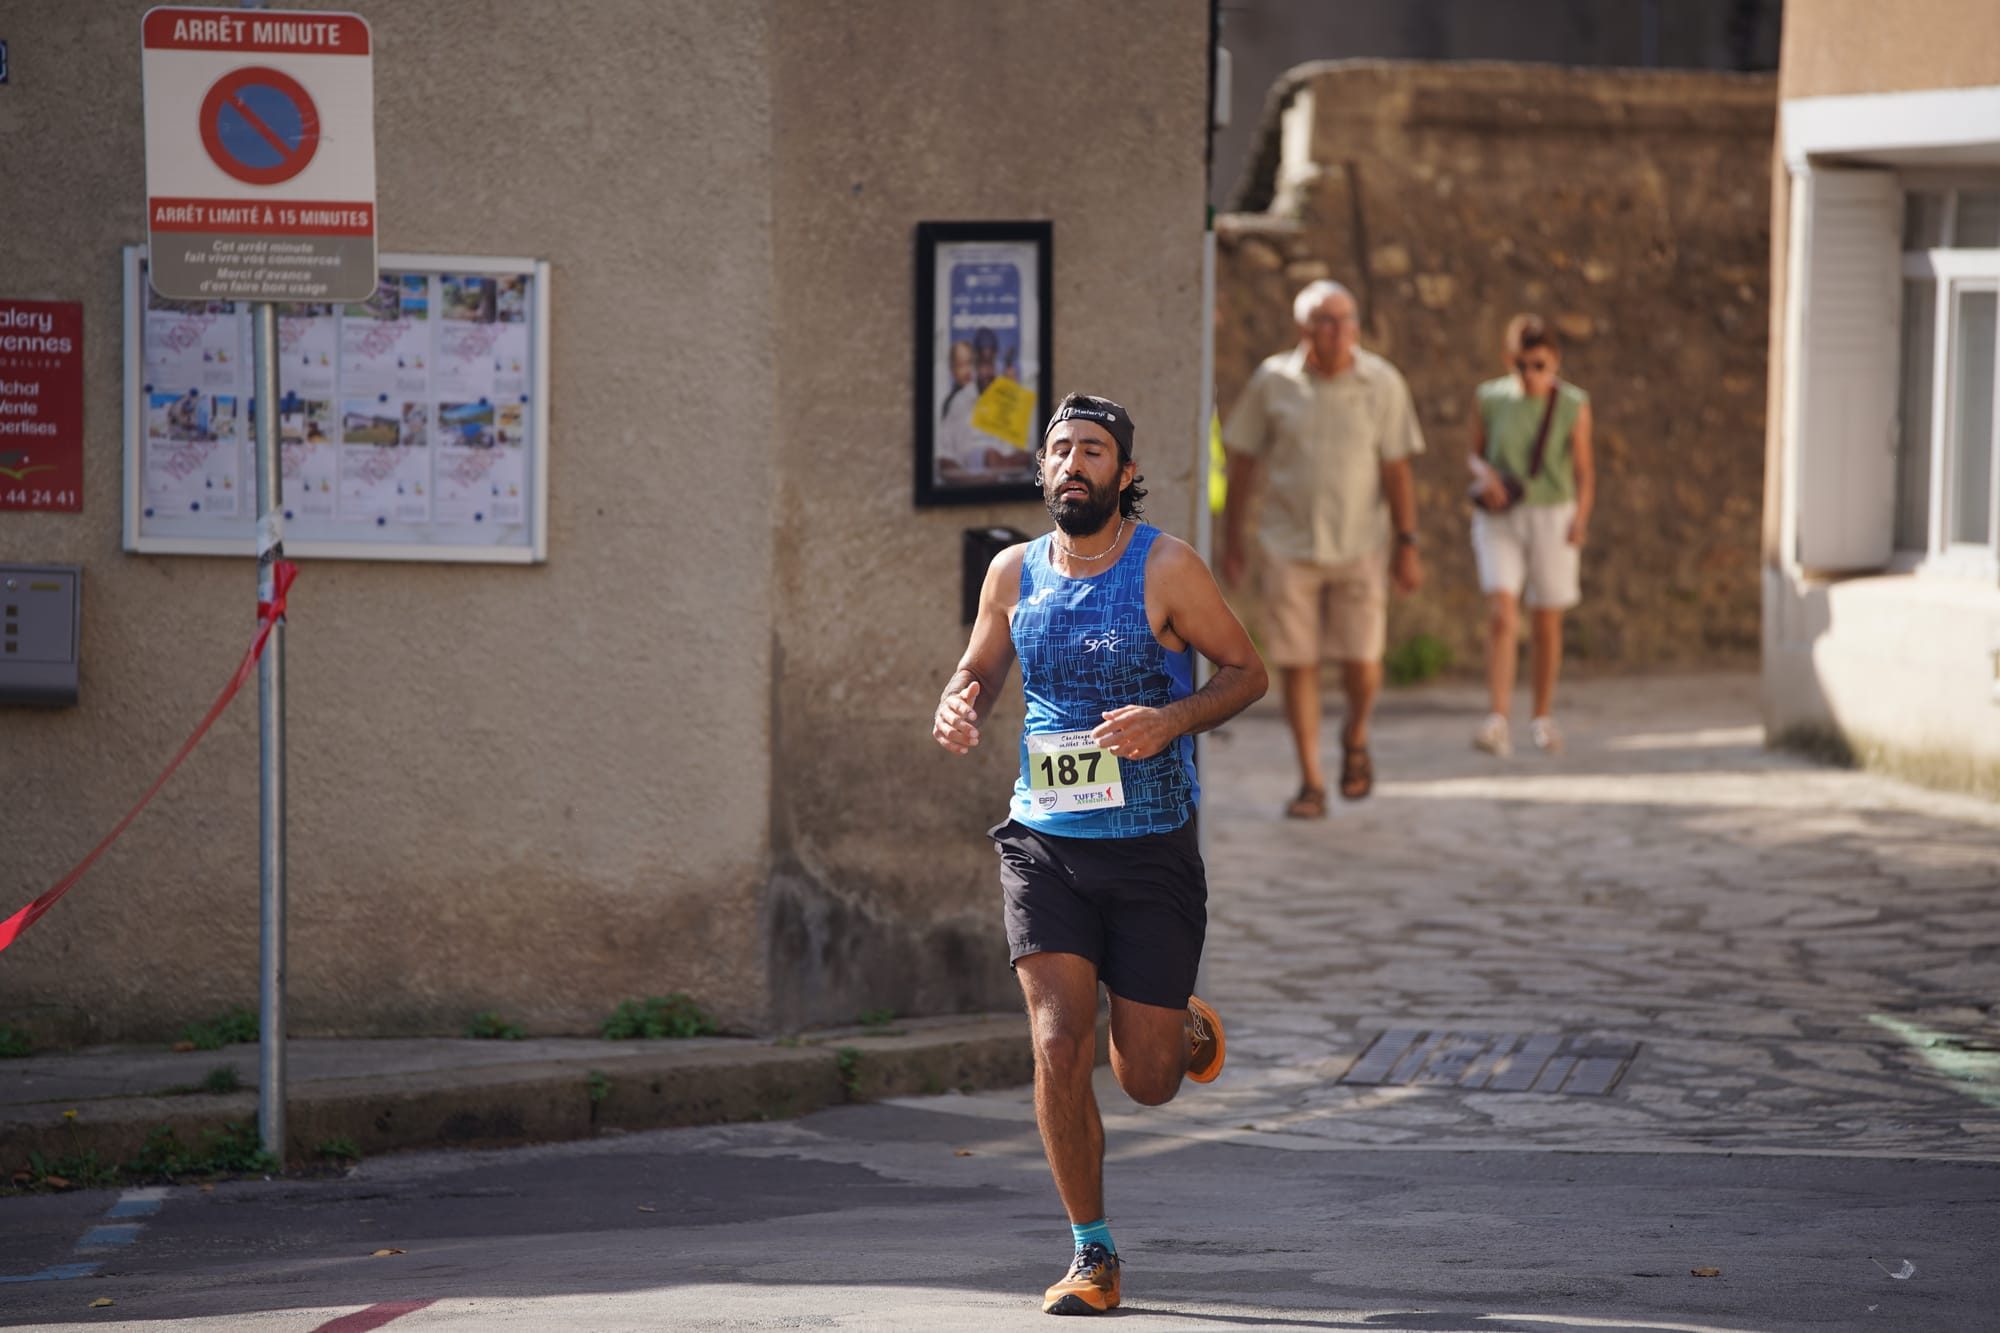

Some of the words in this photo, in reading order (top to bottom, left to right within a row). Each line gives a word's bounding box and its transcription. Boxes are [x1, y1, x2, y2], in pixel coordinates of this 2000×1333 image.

[173, 15, 246, 43] ARRÊT
[253, 21, 341, 46] MINUTE
[156, 205, 204, 223] ARRÊT
[208, 205, 259, 224] LIMITÉ
[263, 205, 274, 224] À
[279, 209, 297, 225] 15
[300, 210, 369, 227] MINUTES
[212, 240, 235, 252] Cet
[237, 240, 268, 253] arrêt
[269, 242, 314, 254] minute
[184, 251, 206, 264] fait
[208, 253, 240, 264] vivre
[242, 255, 265, 265] vos
[267, 255, 341, 266] commerces
[216, 267, 252, 280] Merci
[254, 268, 312, 281] d'avance
[230, 281, 260, 293] faire
[261, 282, 287, 293] bon
[288, 284, 328, 297] usage
[6, 488, 27, 504] 44
[32, 488, 51, 505] 24
[56, 489, 75, 505] 41
[1041, 751, 1102, 787] 187
